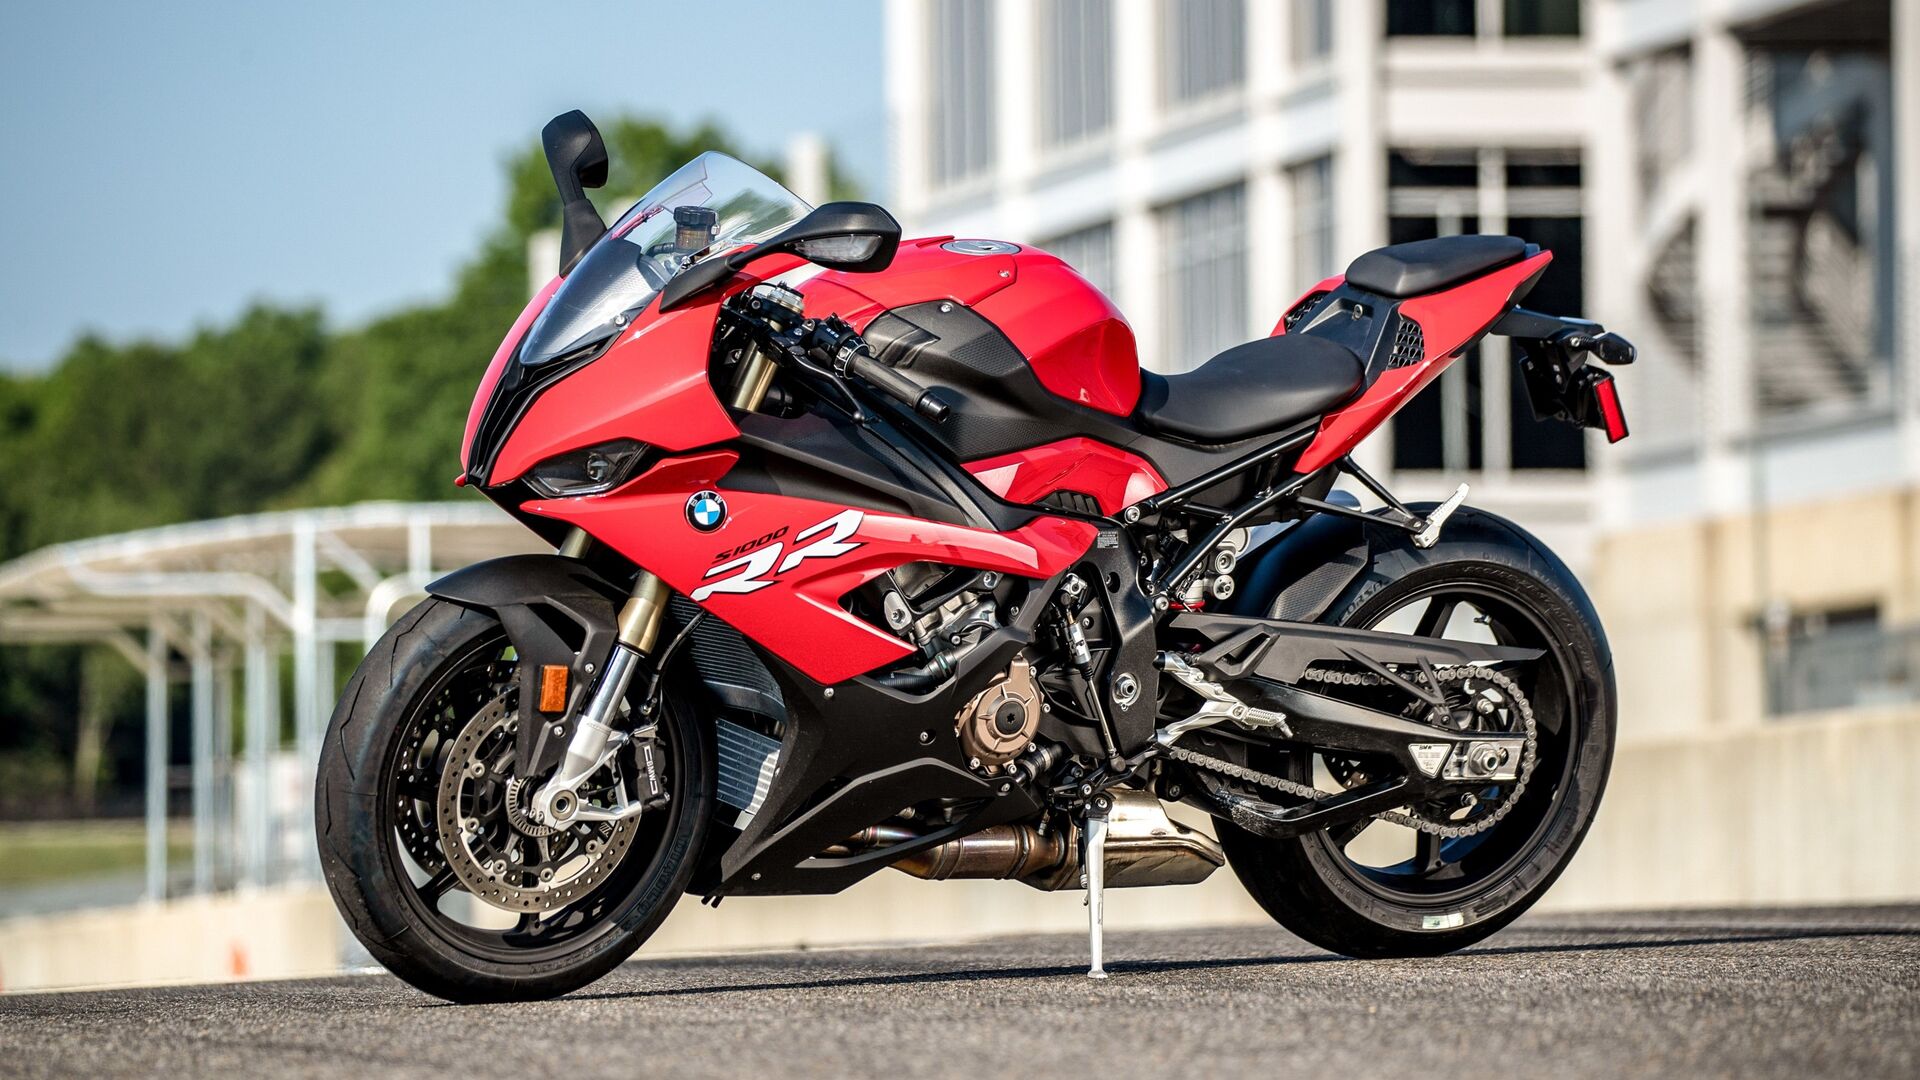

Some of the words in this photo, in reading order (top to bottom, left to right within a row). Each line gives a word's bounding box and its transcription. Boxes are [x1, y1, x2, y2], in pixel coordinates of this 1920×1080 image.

[690, 492, 723, 507] BMW
[690, 509, 868, 602] RR
[712, 526, 789, 564] S1000
[646, 761, 657, 781] BMW
